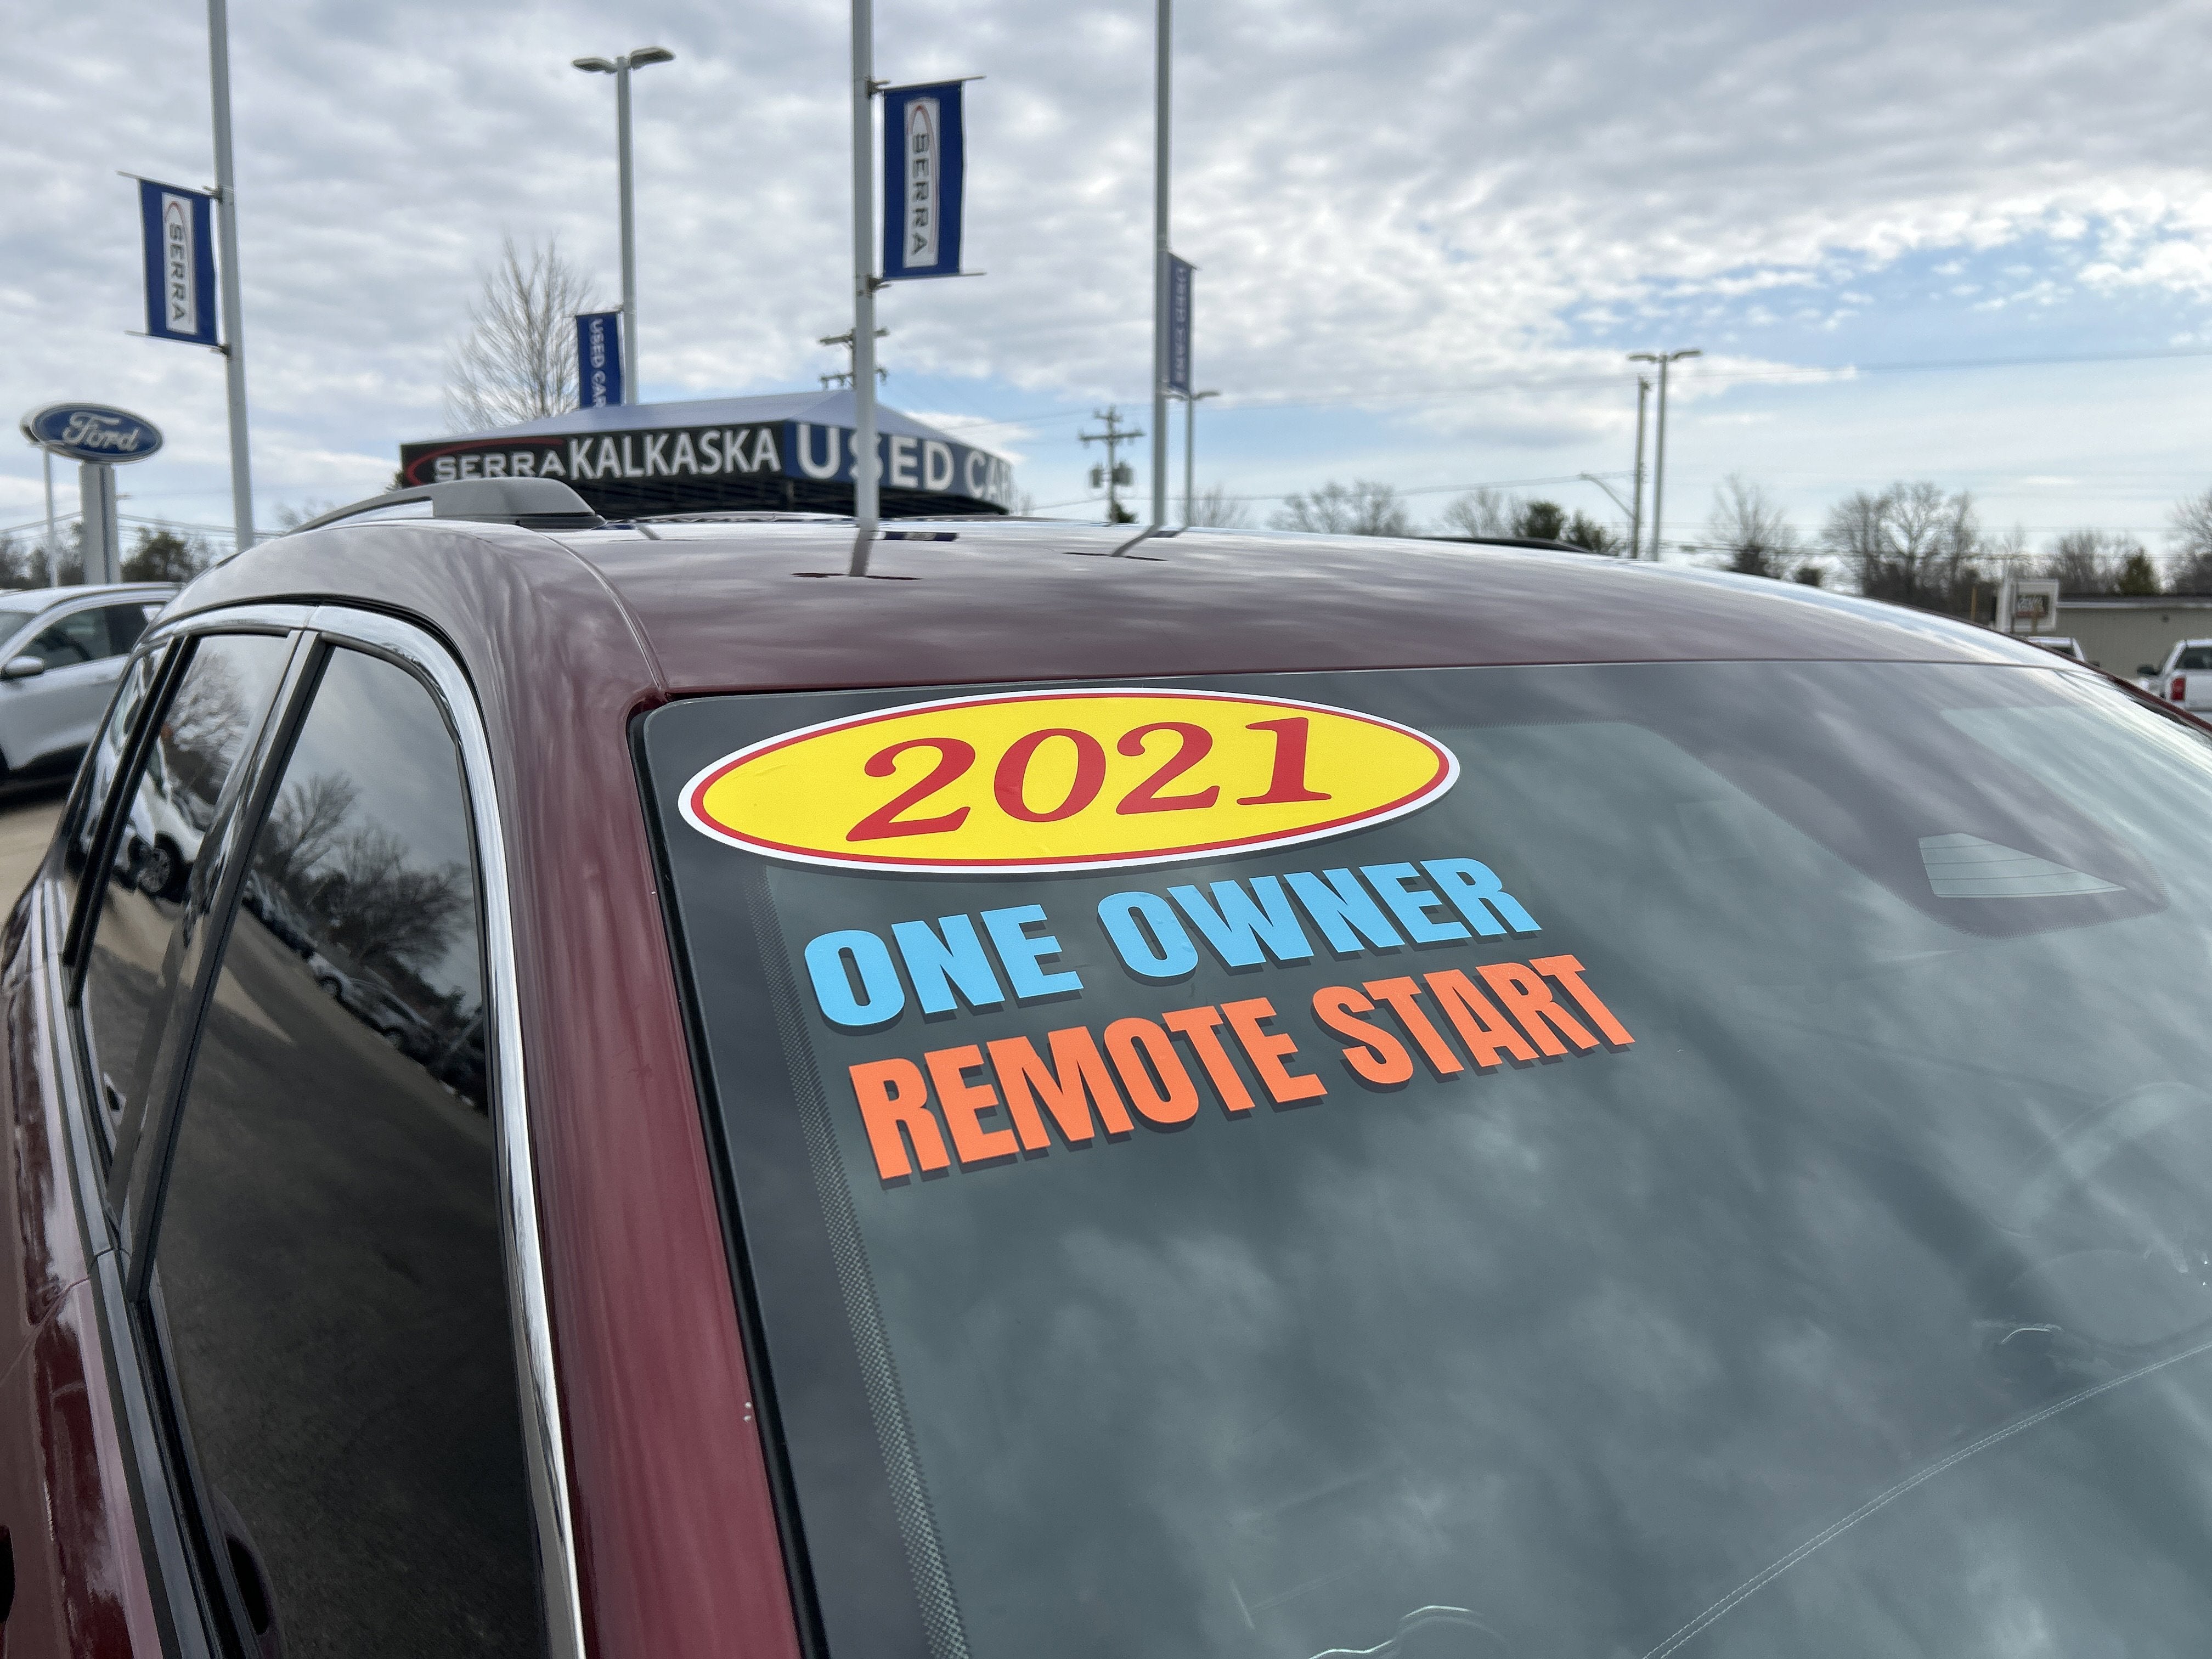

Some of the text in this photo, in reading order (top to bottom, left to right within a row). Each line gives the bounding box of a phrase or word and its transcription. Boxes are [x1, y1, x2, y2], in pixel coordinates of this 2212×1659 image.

[911, 132, 930, 255] SERRA
[168, 222, 185, 321] SERRA
[590, 318, 605, 369] USED
[62, 411, 140, 451] Ford
[435, 427, 782, 482] SERRA KALKASKA
[845, 716, 1332, 842] 2021
[804, 857, 1542, 1026] ONE OWNER
[849, 954, 1635, 1180] REMOTE START
